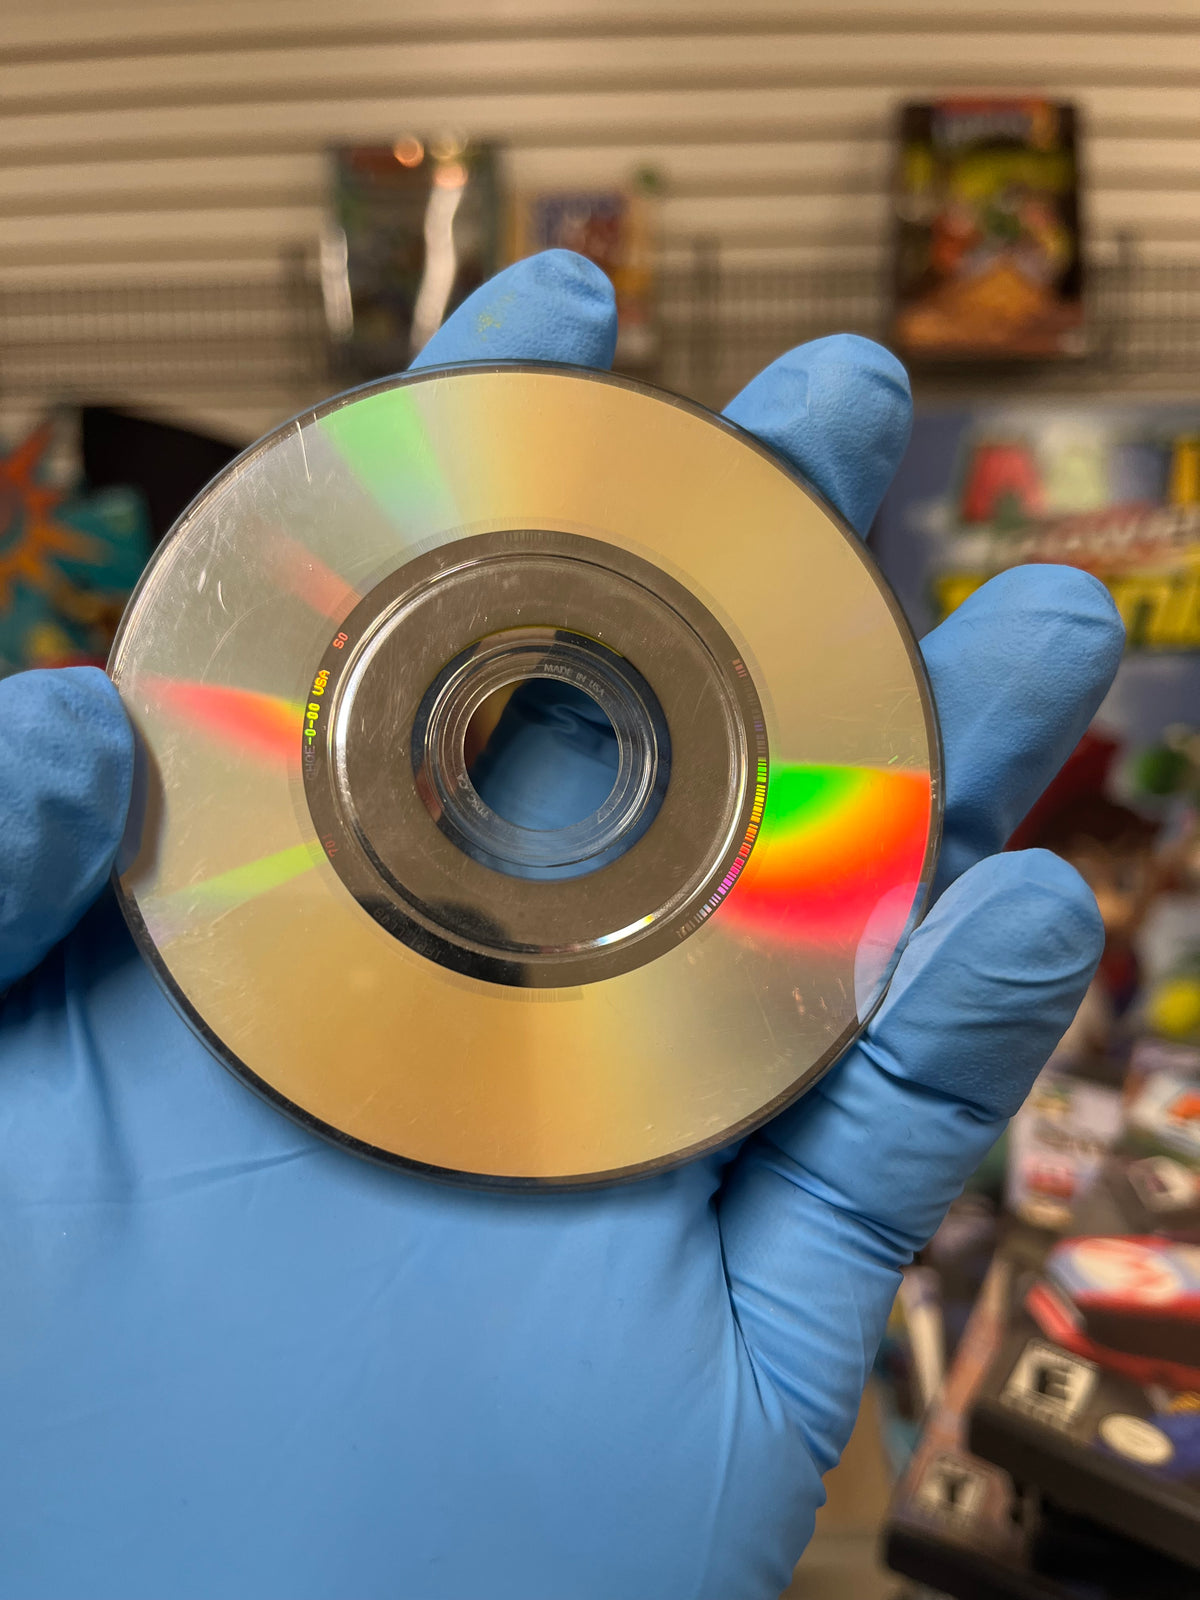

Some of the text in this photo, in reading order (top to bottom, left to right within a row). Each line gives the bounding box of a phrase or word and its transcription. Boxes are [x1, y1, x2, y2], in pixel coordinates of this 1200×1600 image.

[312, 669, 330, 696] USA
[543, 663, 605, 696] MADE IN USA
[1034, 1361, 1070, 1402] E
